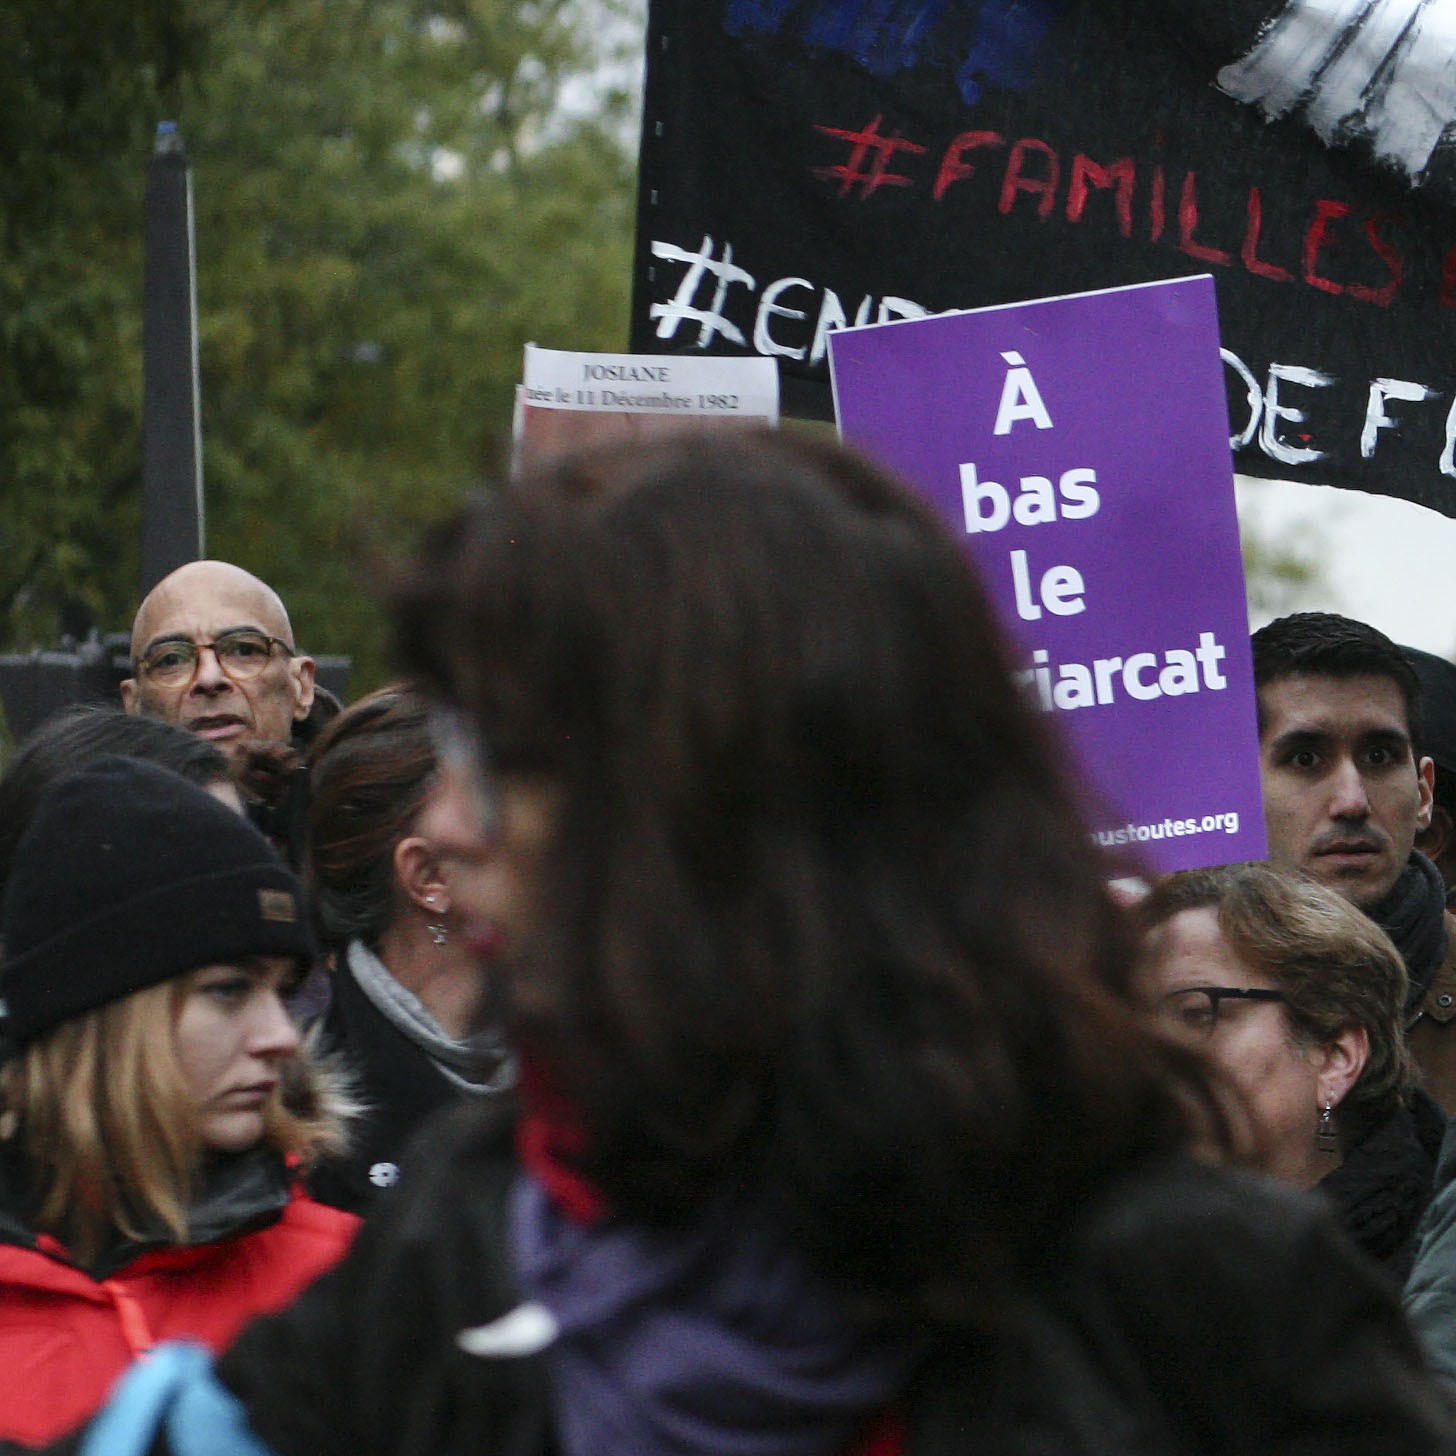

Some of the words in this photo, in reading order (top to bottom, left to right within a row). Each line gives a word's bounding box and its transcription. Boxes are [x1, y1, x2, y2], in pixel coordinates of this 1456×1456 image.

[576, 389, 594, 405] 11
[602, 388, 692, 409] Décembre
[698, 394, 739, 410] 1982
[583, 363, 672, 382] JOSIANE
[993, 350, 1054, 436] À
[959, 462, 1101, 534] bas
[1009, 549, 1087, 621] le
